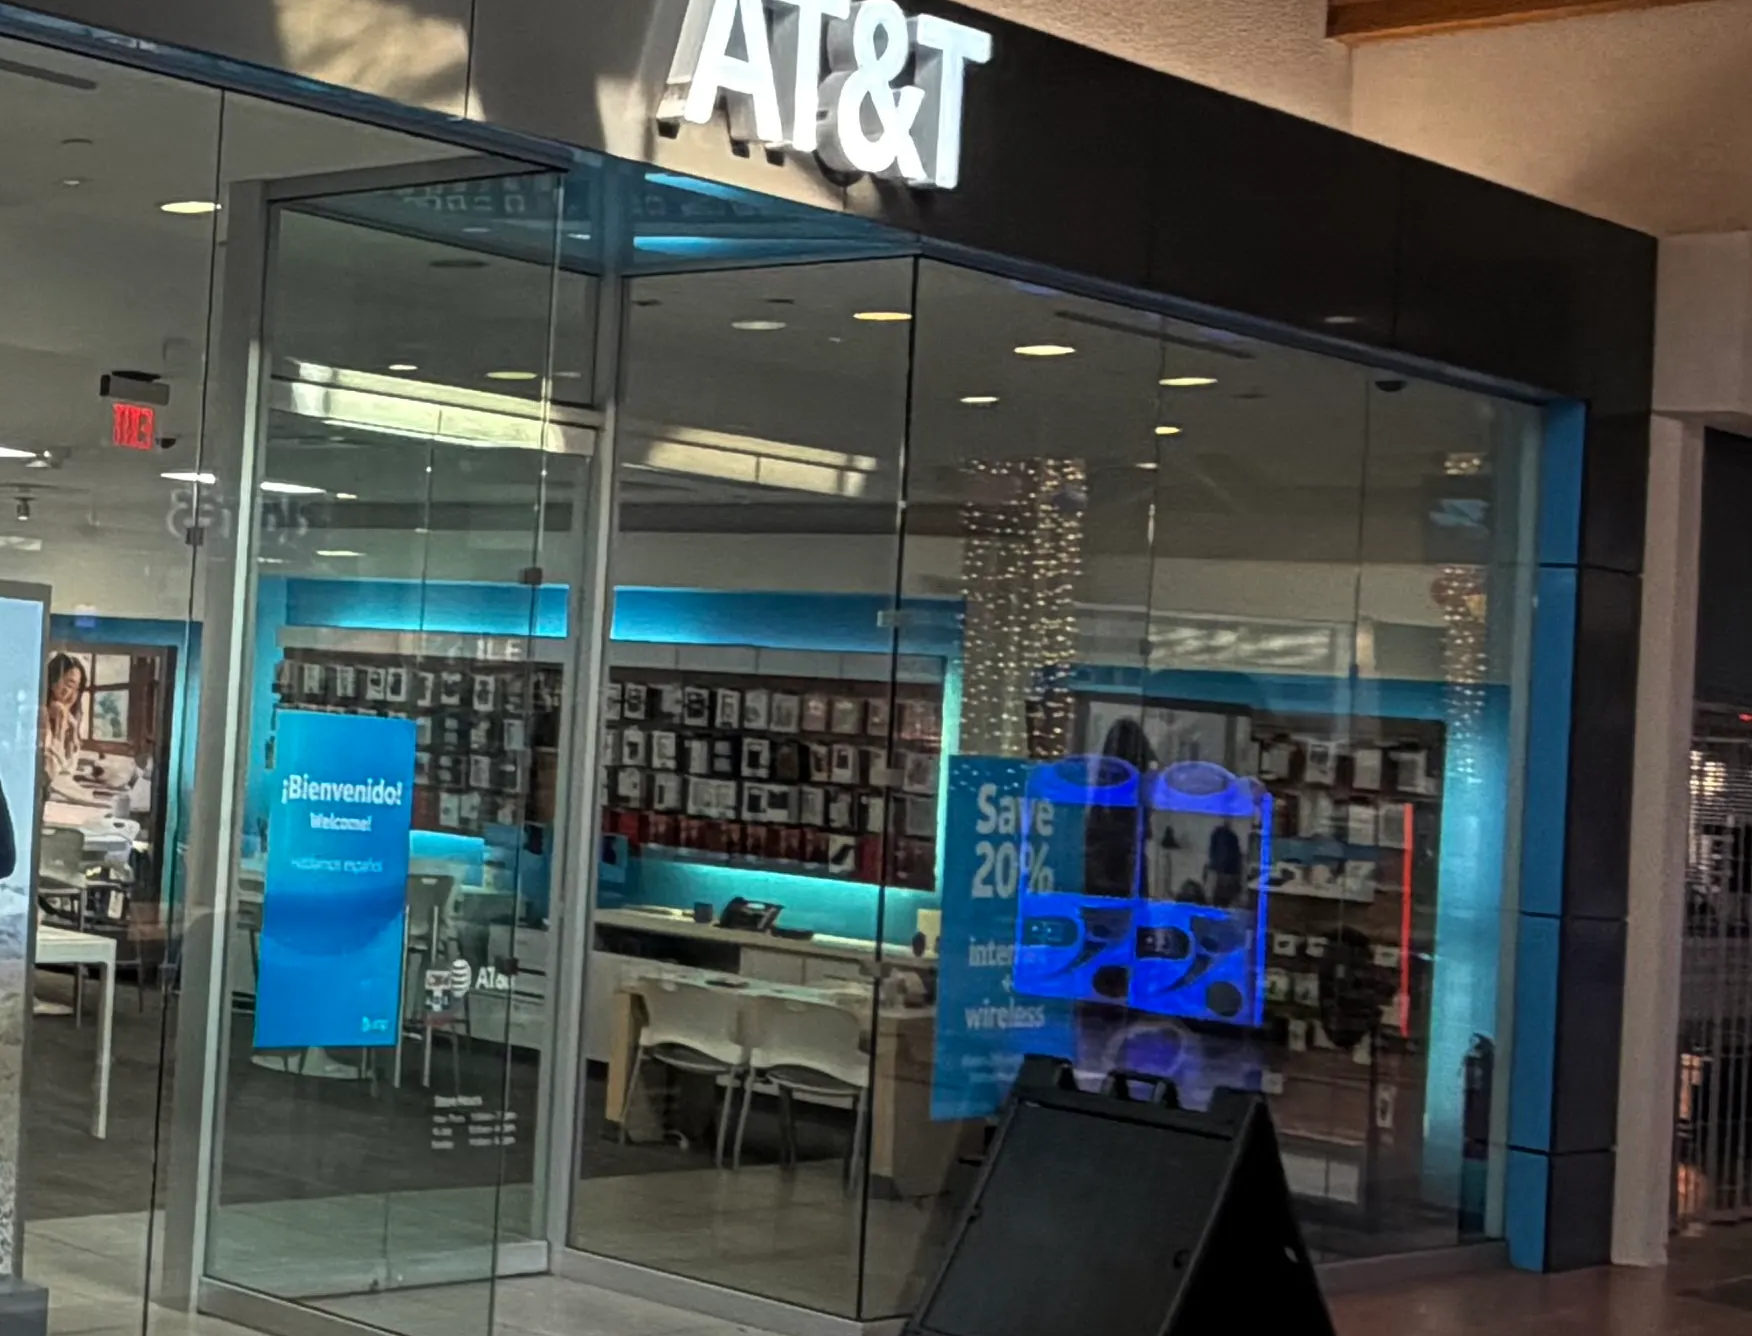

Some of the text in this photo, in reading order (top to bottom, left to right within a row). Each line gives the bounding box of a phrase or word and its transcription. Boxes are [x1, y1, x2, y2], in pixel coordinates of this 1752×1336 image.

[281, 773, 403, 806] ¡Bienvenido!
[309, 812, 373, 832] Welcome!
[975, 782, 1055, 837] Save
[971, 840, 1055, 900] 20%
[964, 996, 1047, 1030] wireless
